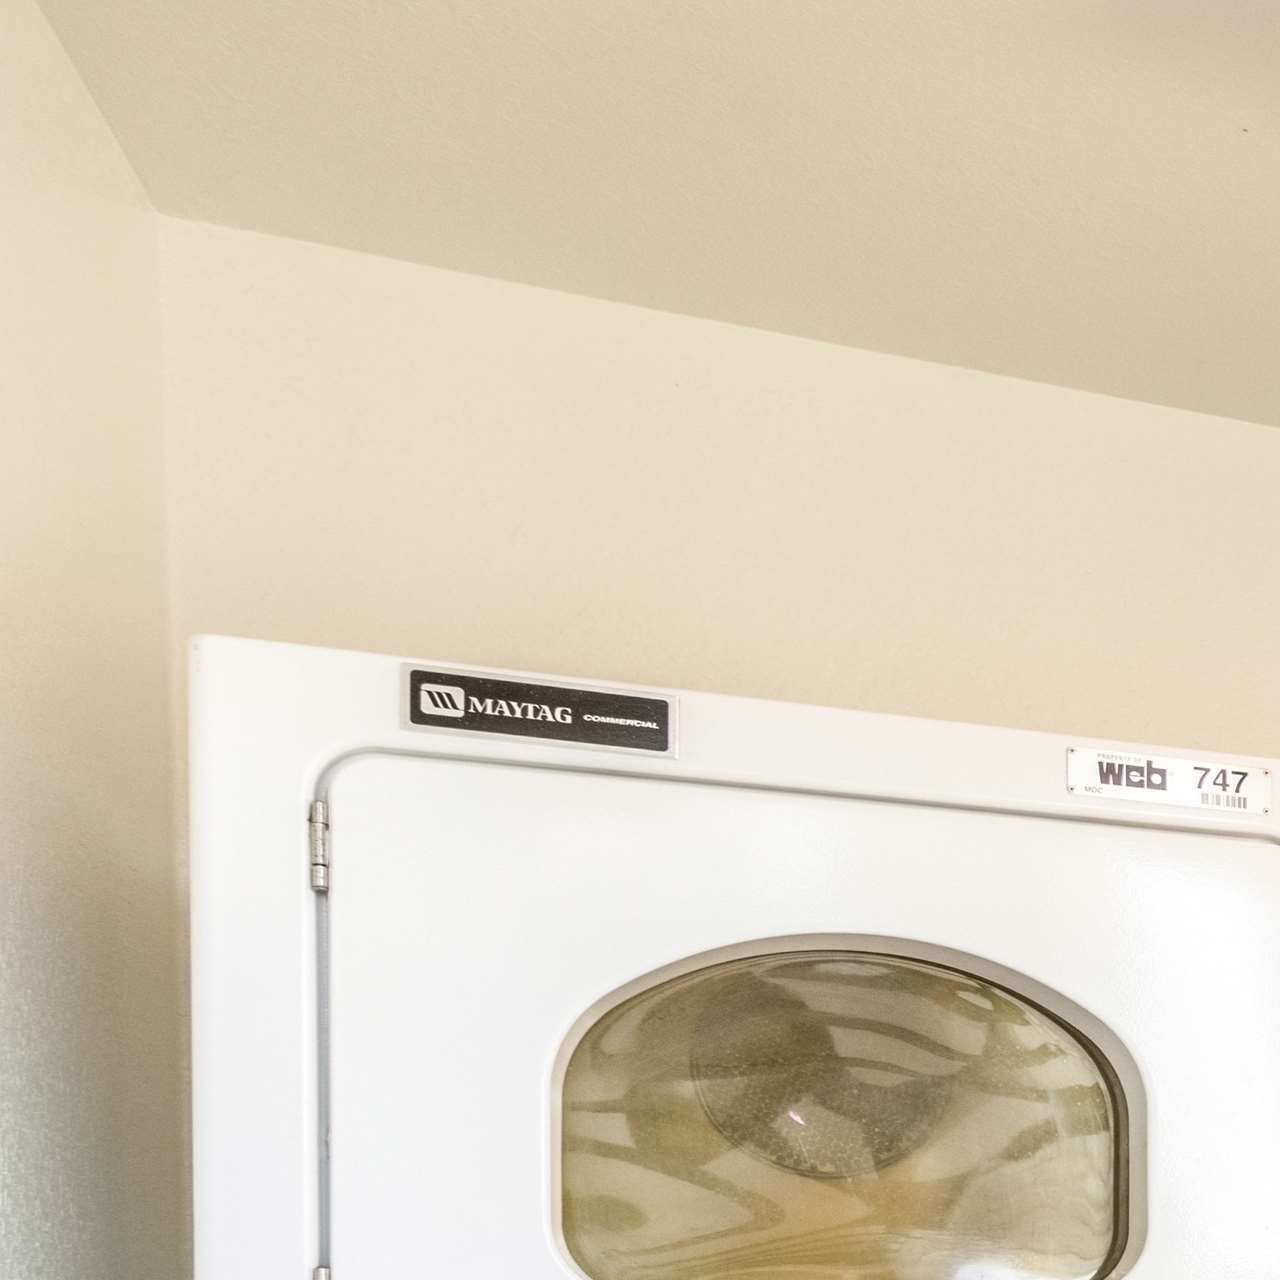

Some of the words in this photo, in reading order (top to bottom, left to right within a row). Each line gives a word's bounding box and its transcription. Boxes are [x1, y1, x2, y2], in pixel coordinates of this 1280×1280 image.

[468, 697, 573, 724] MAYTAG
[583, 714, 660, 729] COMMERCIAL
[1193, 766, 1248, 793] 747
